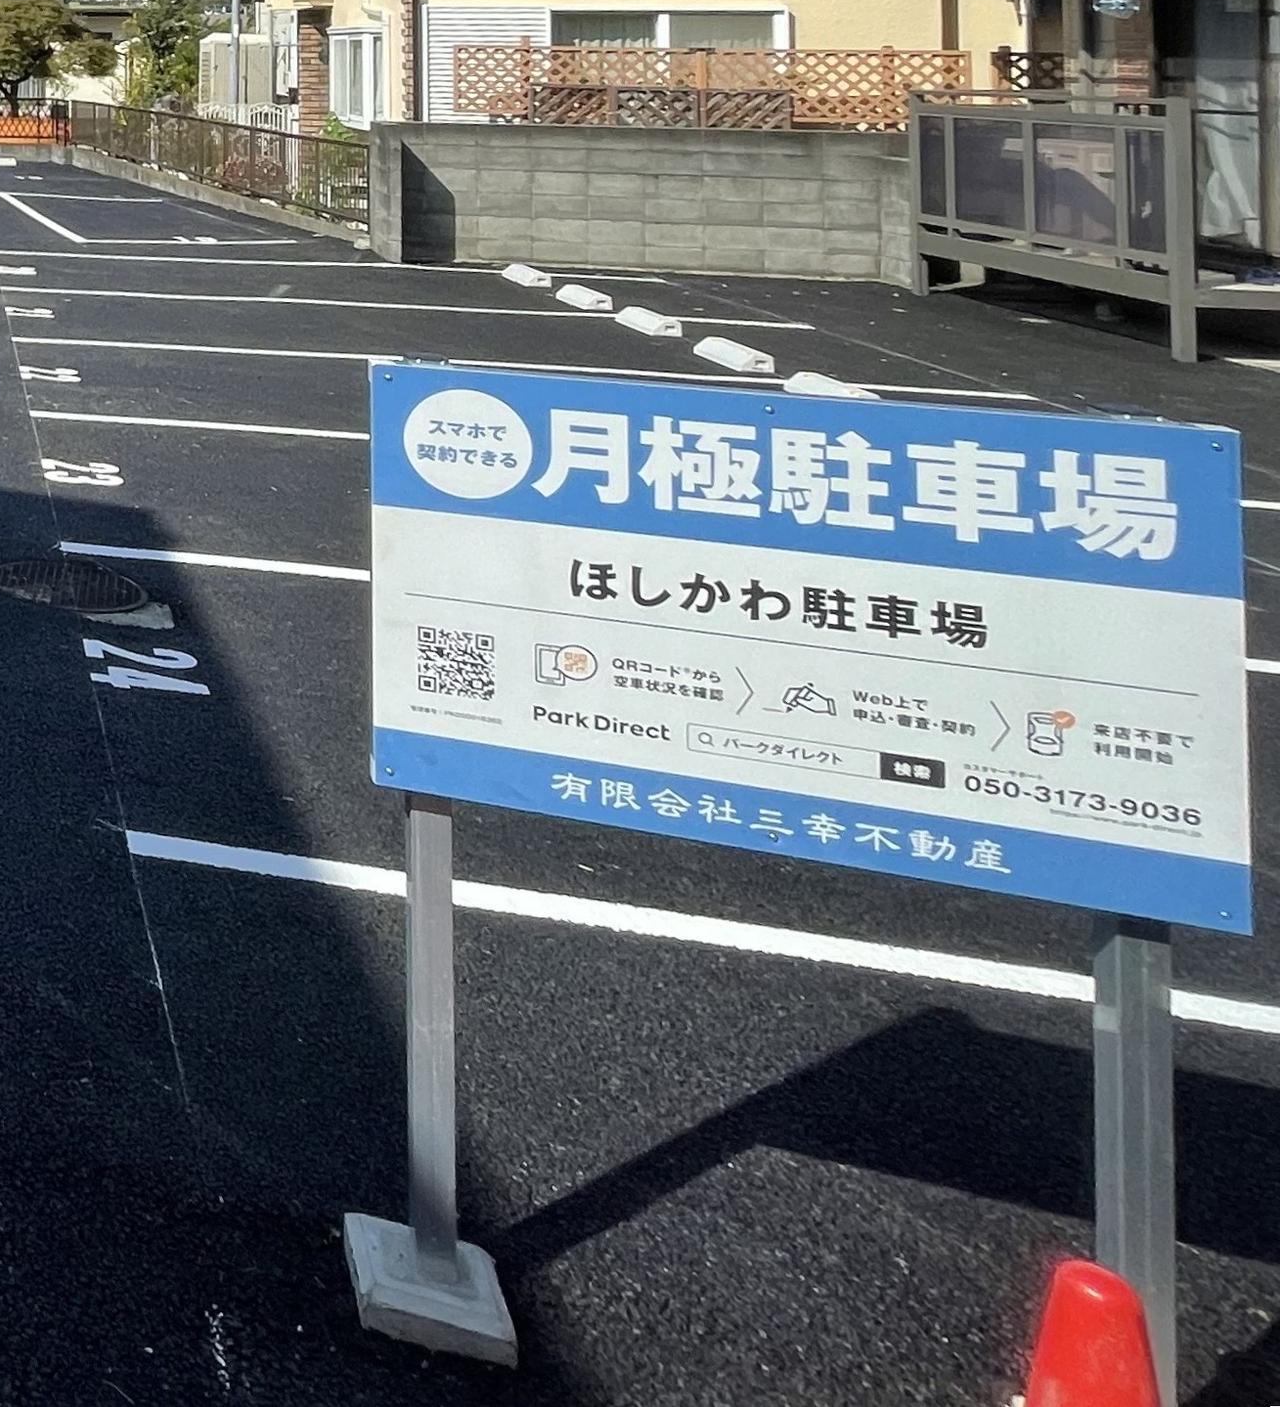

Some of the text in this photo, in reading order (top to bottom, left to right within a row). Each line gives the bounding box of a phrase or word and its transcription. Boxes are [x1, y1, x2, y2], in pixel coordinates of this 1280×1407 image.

[19, 365, 82, 383] 22
[429, 420, 506, 441] スマホで
[41, 458, 125, 486] 23
[417, 443, 518, 468] 契約できる
[531, 408, 1177, 561] 月極駐車場
[569, 559, 989, 649] ほしかわ駐車場
[83, 638, 211, 695] 24
[853, 690, 928, 711] Web上で
[533, 705, 671, 741] Park Direct
[965, 776, 1201, 826] 050-3173-9036
[551, 772, 1011, 873] 有限会社三幸不動産
